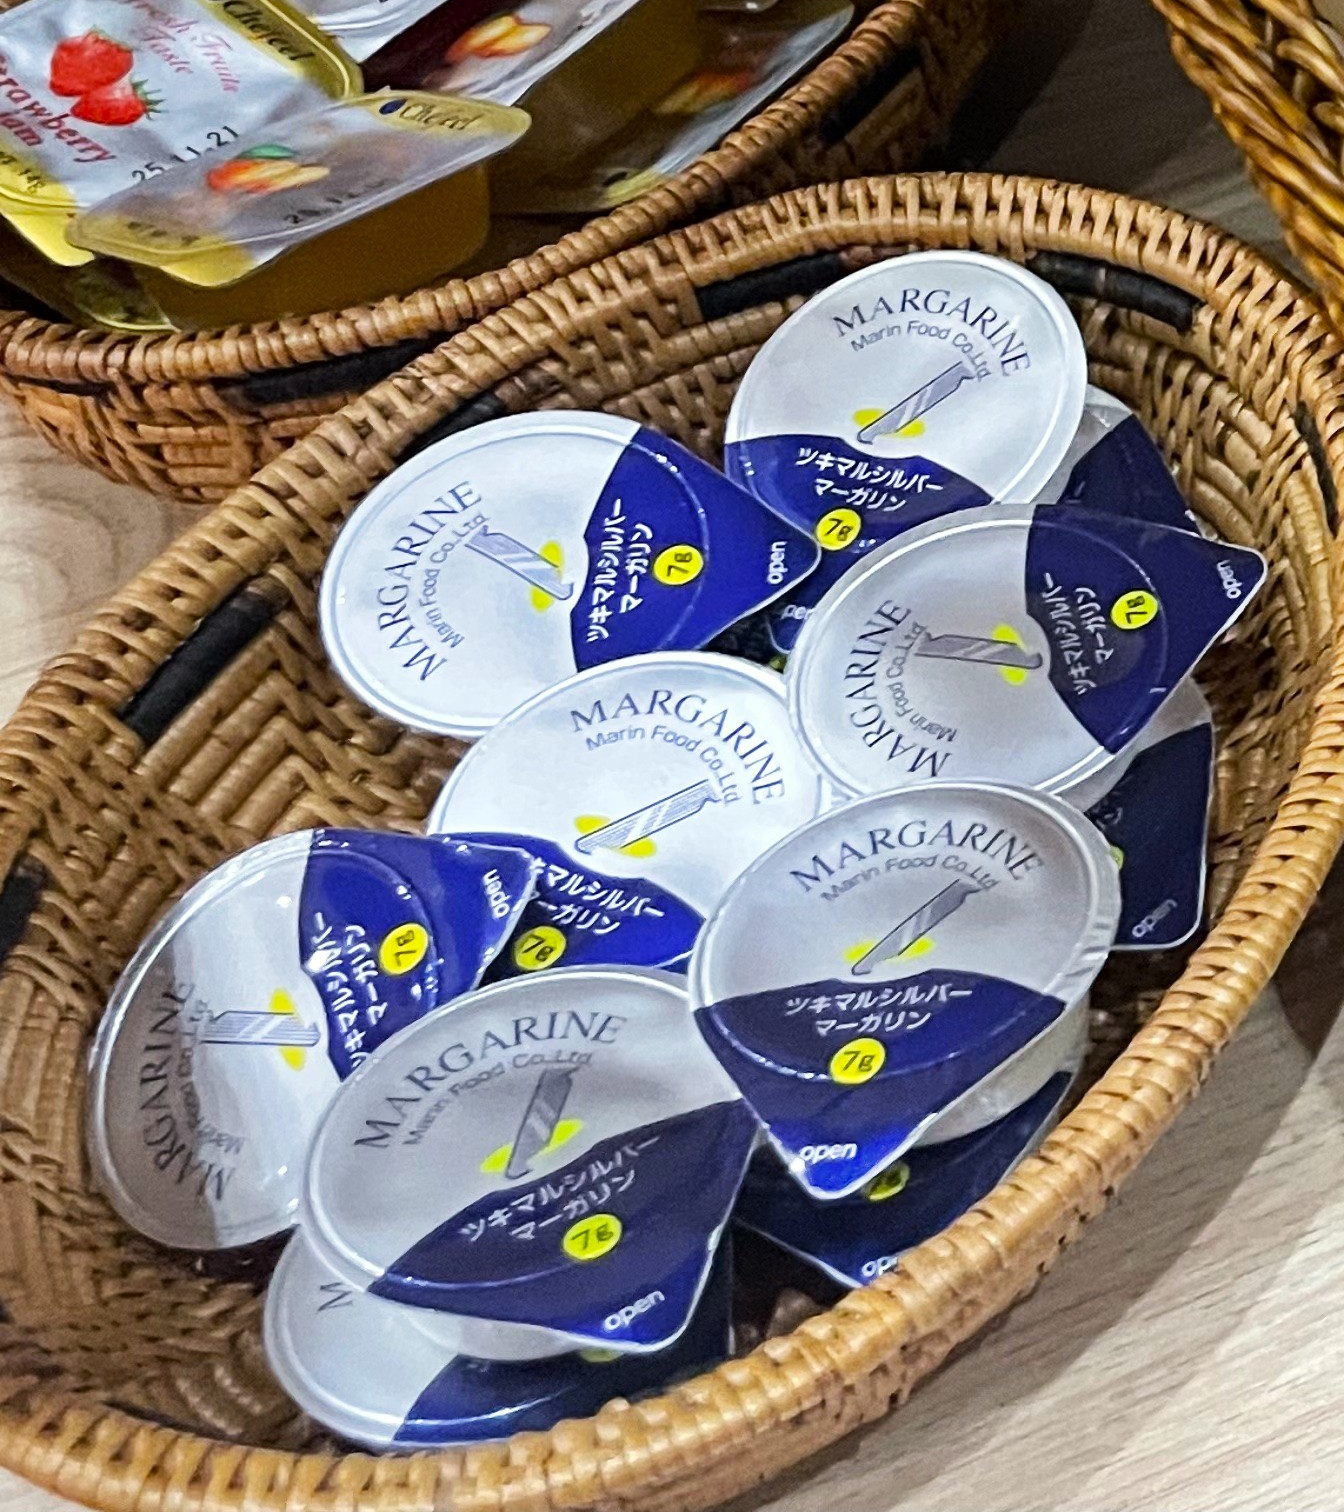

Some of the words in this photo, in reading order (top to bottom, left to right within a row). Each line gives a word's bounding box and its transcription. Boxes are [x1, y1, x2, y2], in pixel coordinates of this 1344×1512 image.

[0, 53, 117, 163] rawberry
[833, 287, 1032, 378] MARGARINE
[850, 323, 901, 353] Marin
[906, 319, 951, 341] Food
[795, 446, 945, 494] ツキマルシルバー
[813, 478, 908, 513] マーガリン
[825, 515, 854, 543] 7g
[377, 480, 482, 681] MARGARINE
[586, 498, 622, 644] ツキマルシルバー
[618, 521, 654, 615] マーガリン
[665, 550, 694, 579] 7g
[766, 540, 789, 585] open
[1215, 559, 1242, 600] open
[418, 568, 441, 610] Food
[1123, 595, 1149, 625] 7g
[427, 609, 465, 649] Marin
[1042, 571, 1097, 695] ツキマルシルバー
[1074, 586, 1115, 665] マーガリン
[844, 598, 952, 779] MARGARINE
[586, 726, 646, 751] Marin
[651, 724, 703, 754] Food
[908, 707, 958, 743] Marin
[570, 689, 786, 805] MARGARINE
[789, 818, 1046, 893] MARGARINE
[482, 868, 512, 920] open
[532, 858, 666, 919] キマルシルバー
[820, 864, 881, 904] Marin
[884, 853, 938, 873] Food
[534, 893, 621, 935] ーガリン
[393, 928, 417, 967] 7g
[522, 934, 557, 964] 7g
[344, 924, 389, 1027] マーガリン
[786, 982, 973, 1016] ツキマルシルバー
[814, 1010, 933, 1037] マーガリン
[353, 1010, 628, 1149] MARGARINE
[448, 1059, 506, 1097] Food
[839, 1049, 876, 1074] 7g
[799, 1140, 858, 1165] open
[459, 1135, 662, 1244] ツキマルシルバー
[508, 1168, 636, 1242] マーガリン
[569, 1223, 615, 1253] 7g
[861, 1256, 898, 1276] op
[603, 1290, 667, 1332] open
